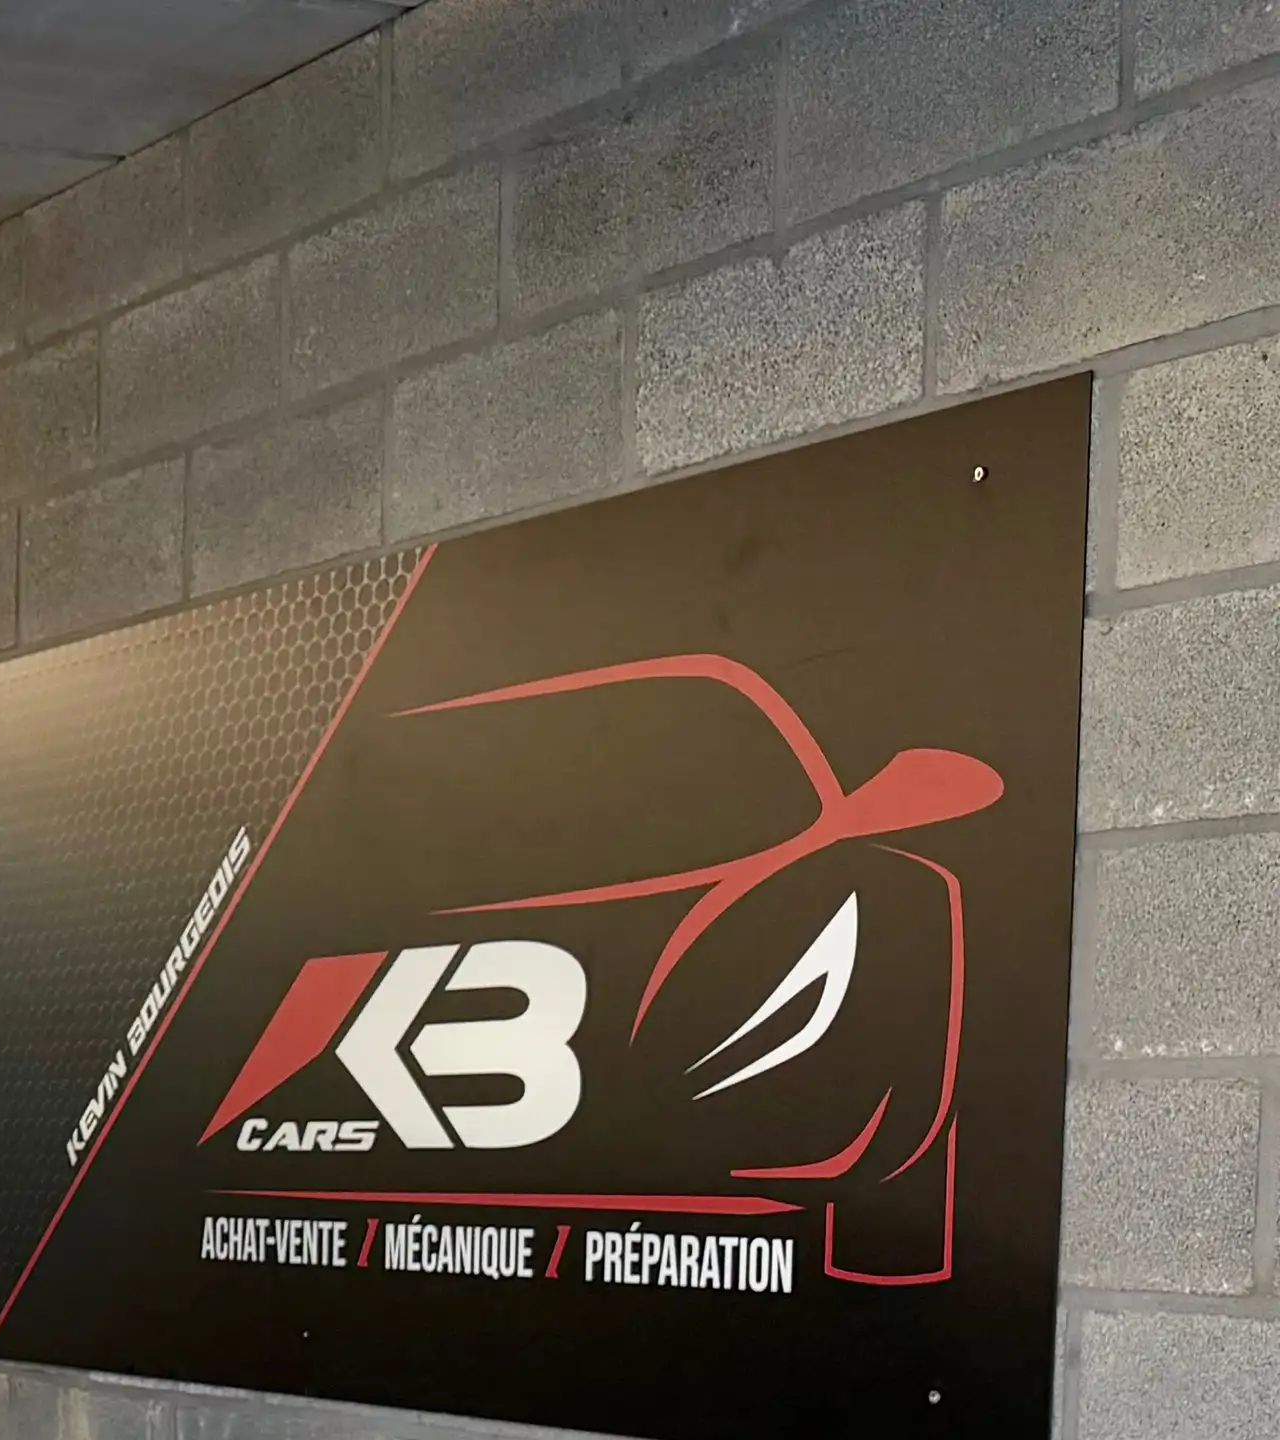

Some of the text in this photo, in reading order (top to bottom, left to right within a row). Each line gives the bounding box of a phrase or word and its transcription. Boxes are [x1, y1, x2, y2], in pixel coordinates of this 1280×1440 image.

[66, 825, 252, 1167] KEVIN BOURGEOIS
[197, 940, 588, 1149] KB
[236, 1117, 380, 1152] CARS
[200, 1216, 348, 1267] ACHAT-VENTE
[384, 1213, 536, 1280] MÉCANIQUE
[584, 1220, 794, 1294] PRÉPARATION
